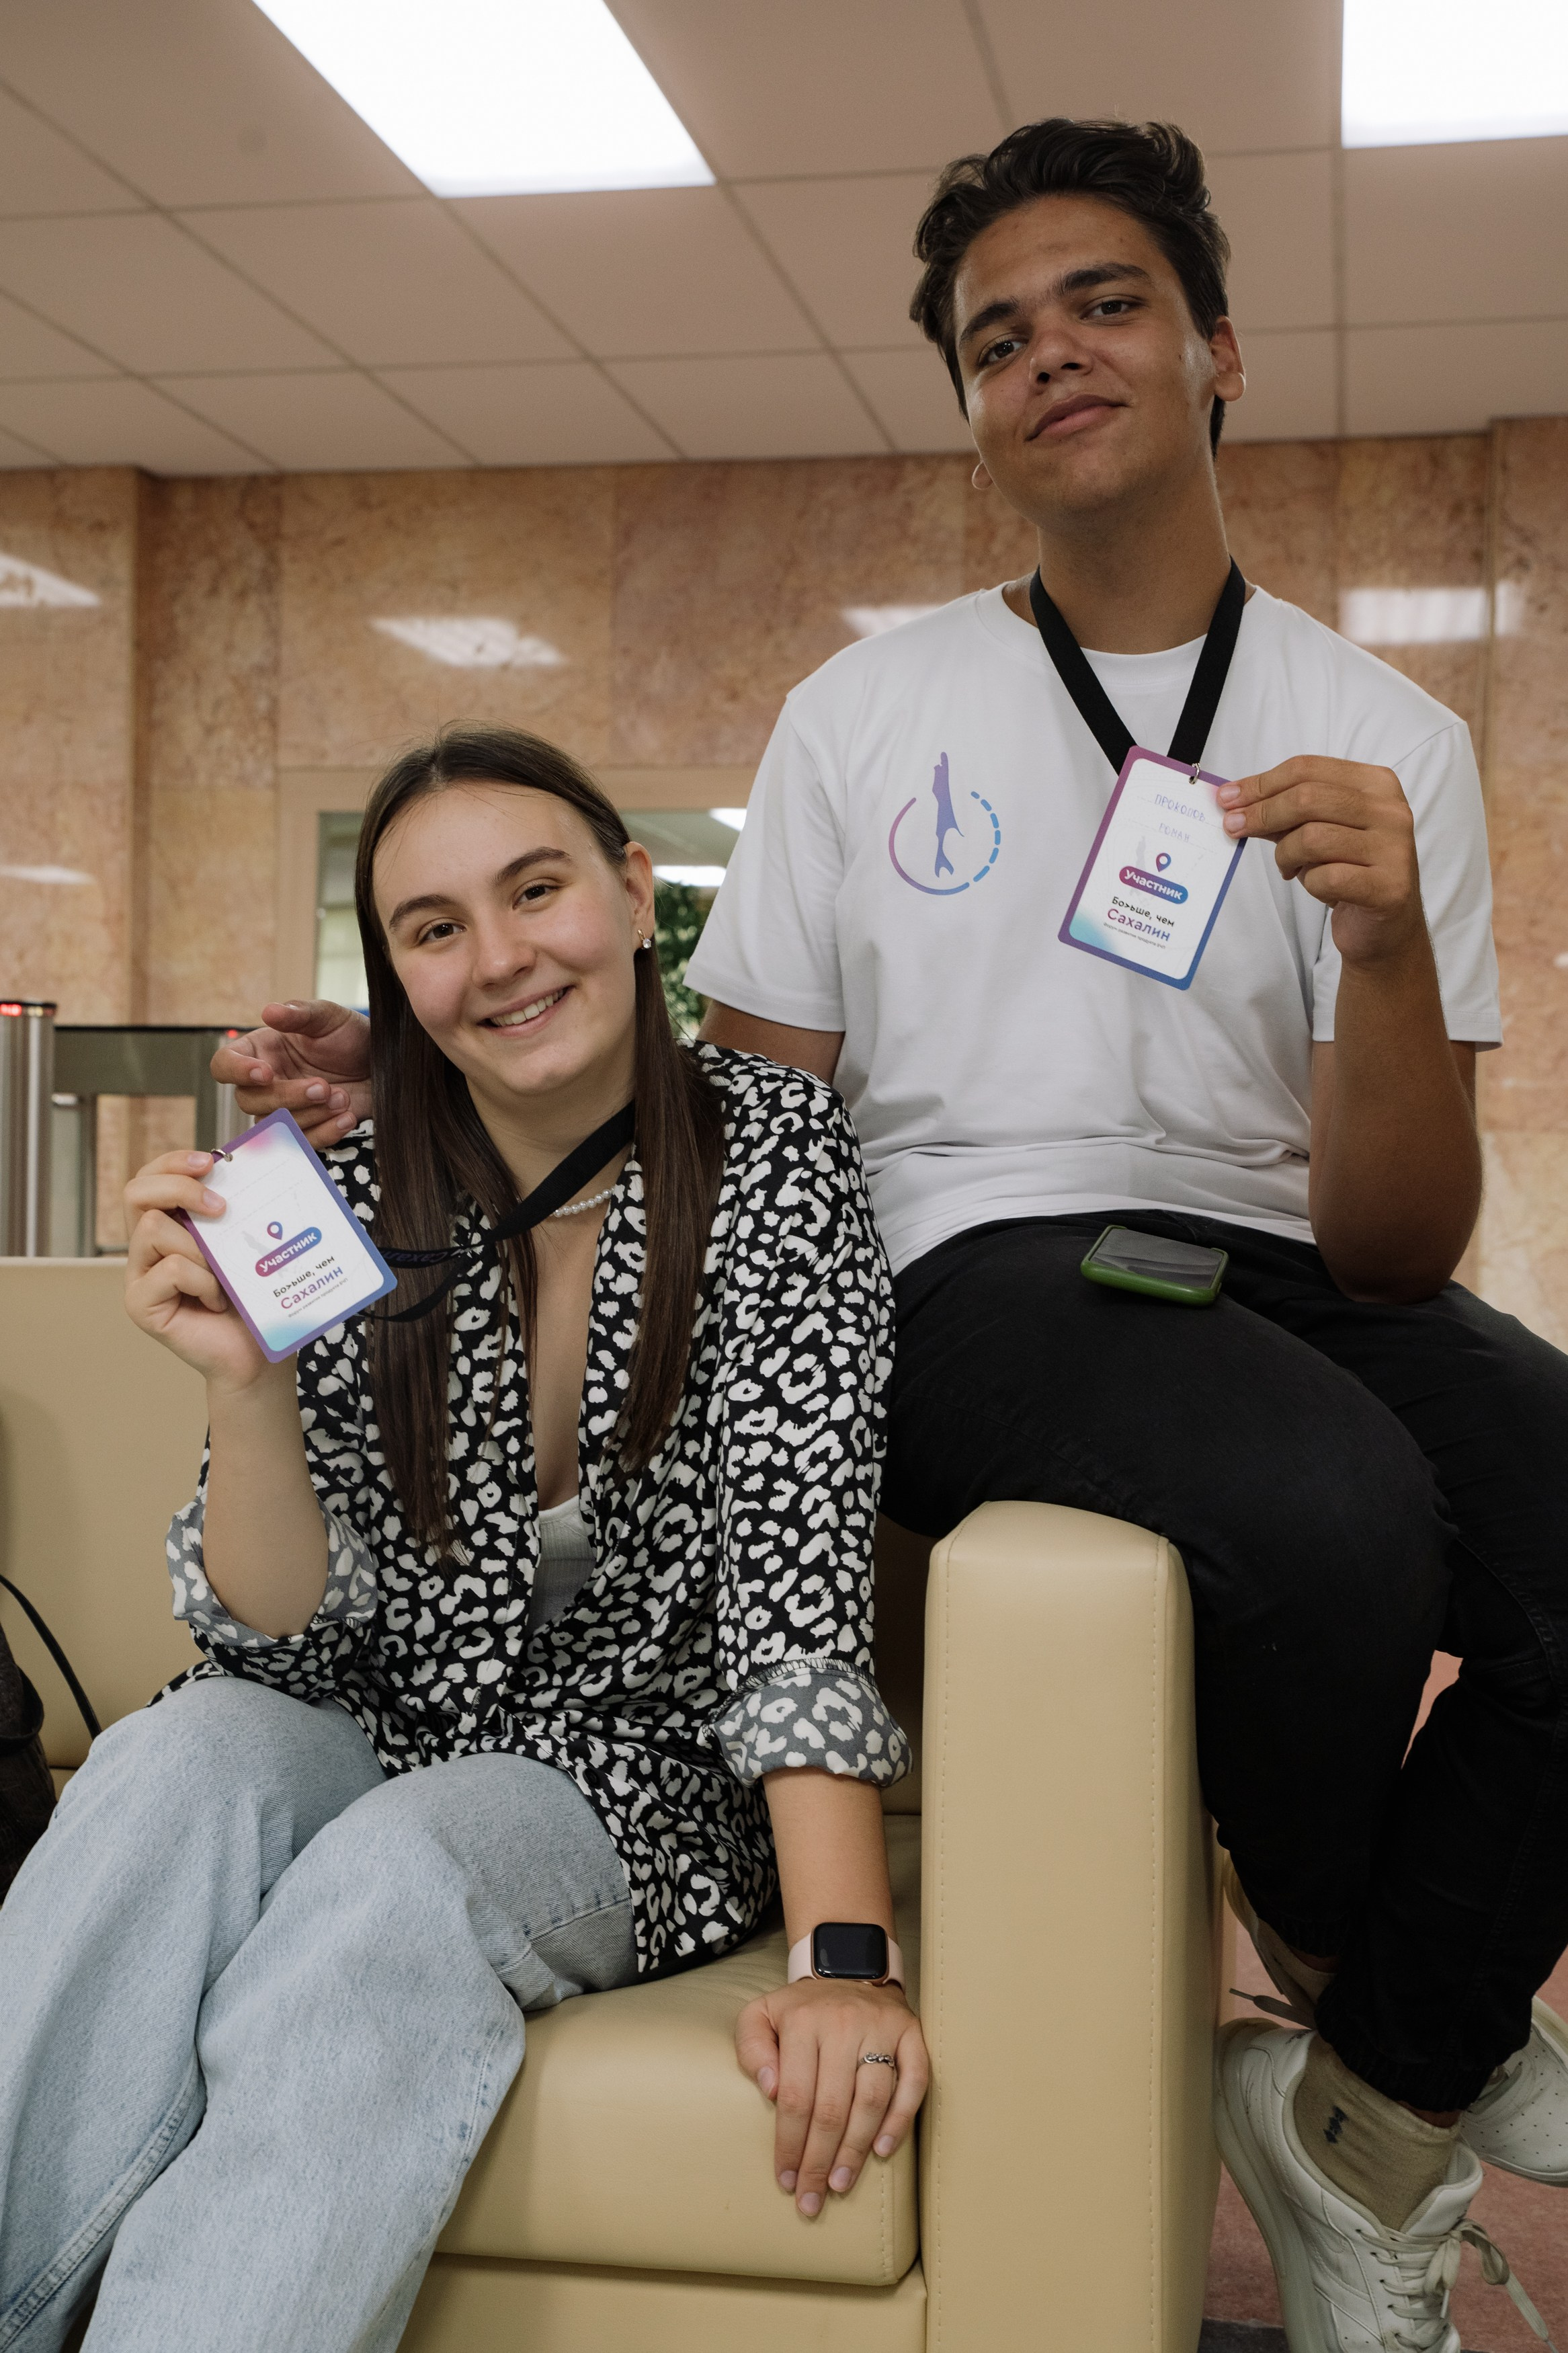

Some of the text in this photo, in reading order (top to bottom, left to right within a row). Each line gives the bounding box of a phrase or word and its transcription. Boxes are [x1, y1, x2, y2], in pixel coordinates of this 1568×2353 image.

[1124, 869, 1183, 900] Участник
[1107, 908, 1170, 941] Сахалин
[1156, 915, 1175, 927] чем
[259, 1232, 317, 1273] Участник
[315, 1256, 335, 1269] чем
[281, 1267, 343, 1310] Сахалин
